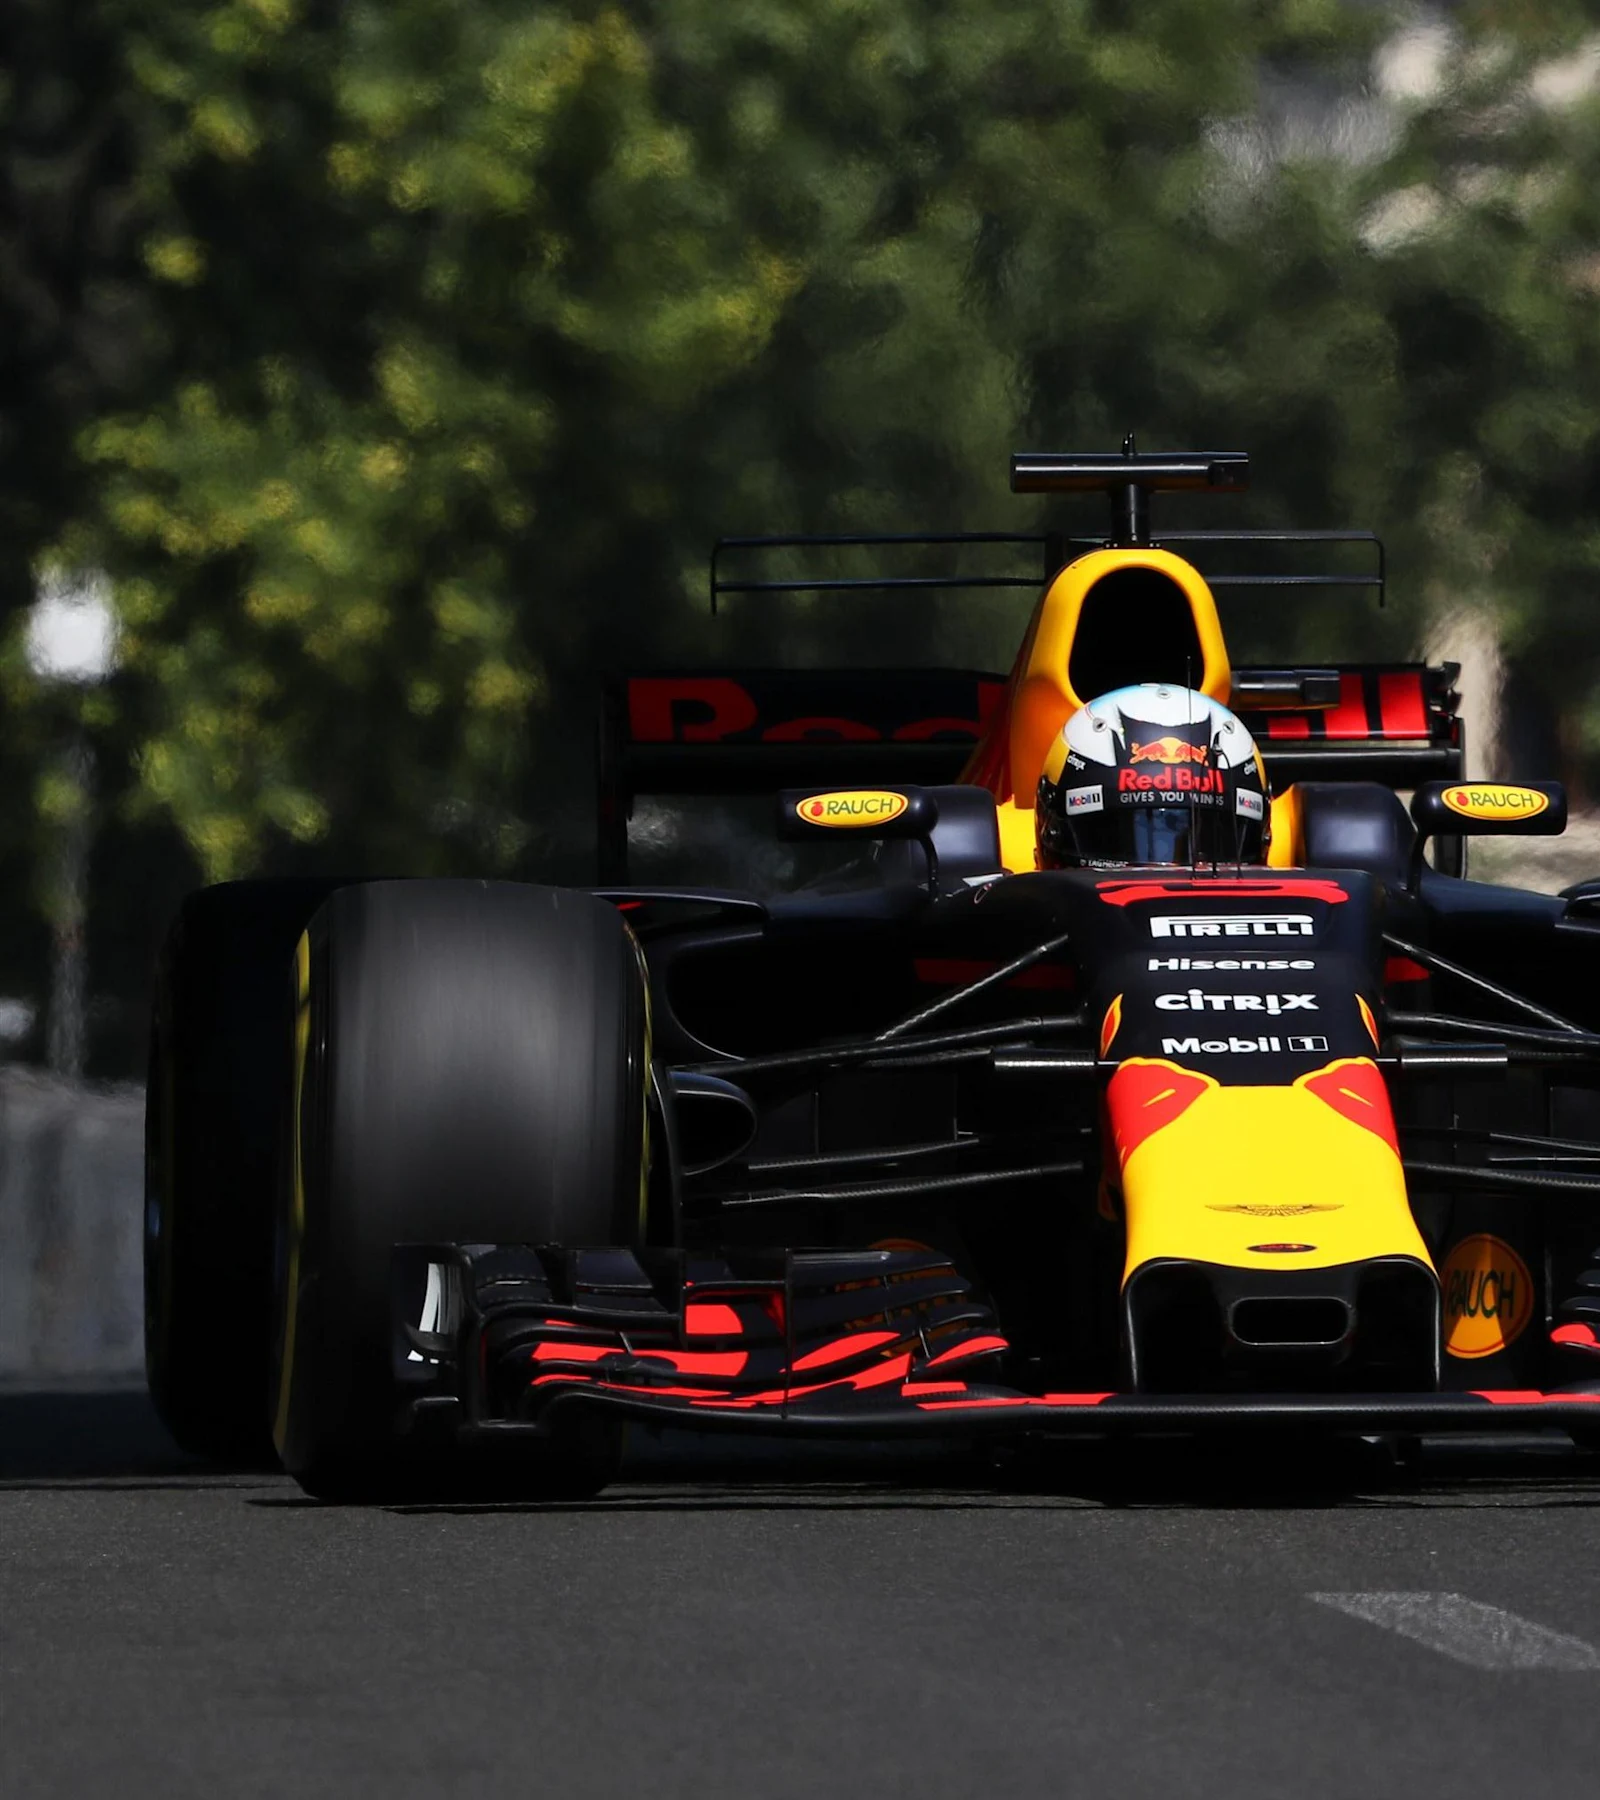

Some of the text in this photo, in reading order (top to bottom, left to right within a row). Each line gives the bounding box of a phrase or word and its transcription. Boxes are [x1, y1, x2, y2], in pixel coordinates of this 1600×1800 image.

[1119, 766, 1172, 792] Red
[1175, 767, 1225, 793] Bull
[1069, 794, 1092, 807] Mobil
[1120, 791, 1155, 803] GIVES
[1159, 791, 1185, 802] YOU
[1470, 792, 1534, 808] RAUCH
[827, 798, 894, 816] RAUCH
[1150, 914, 1314, 938] PIRELLI
[1148, 958, 1315, 971] Hisense
[1161, 1036, 1281, 1054] Mobil
